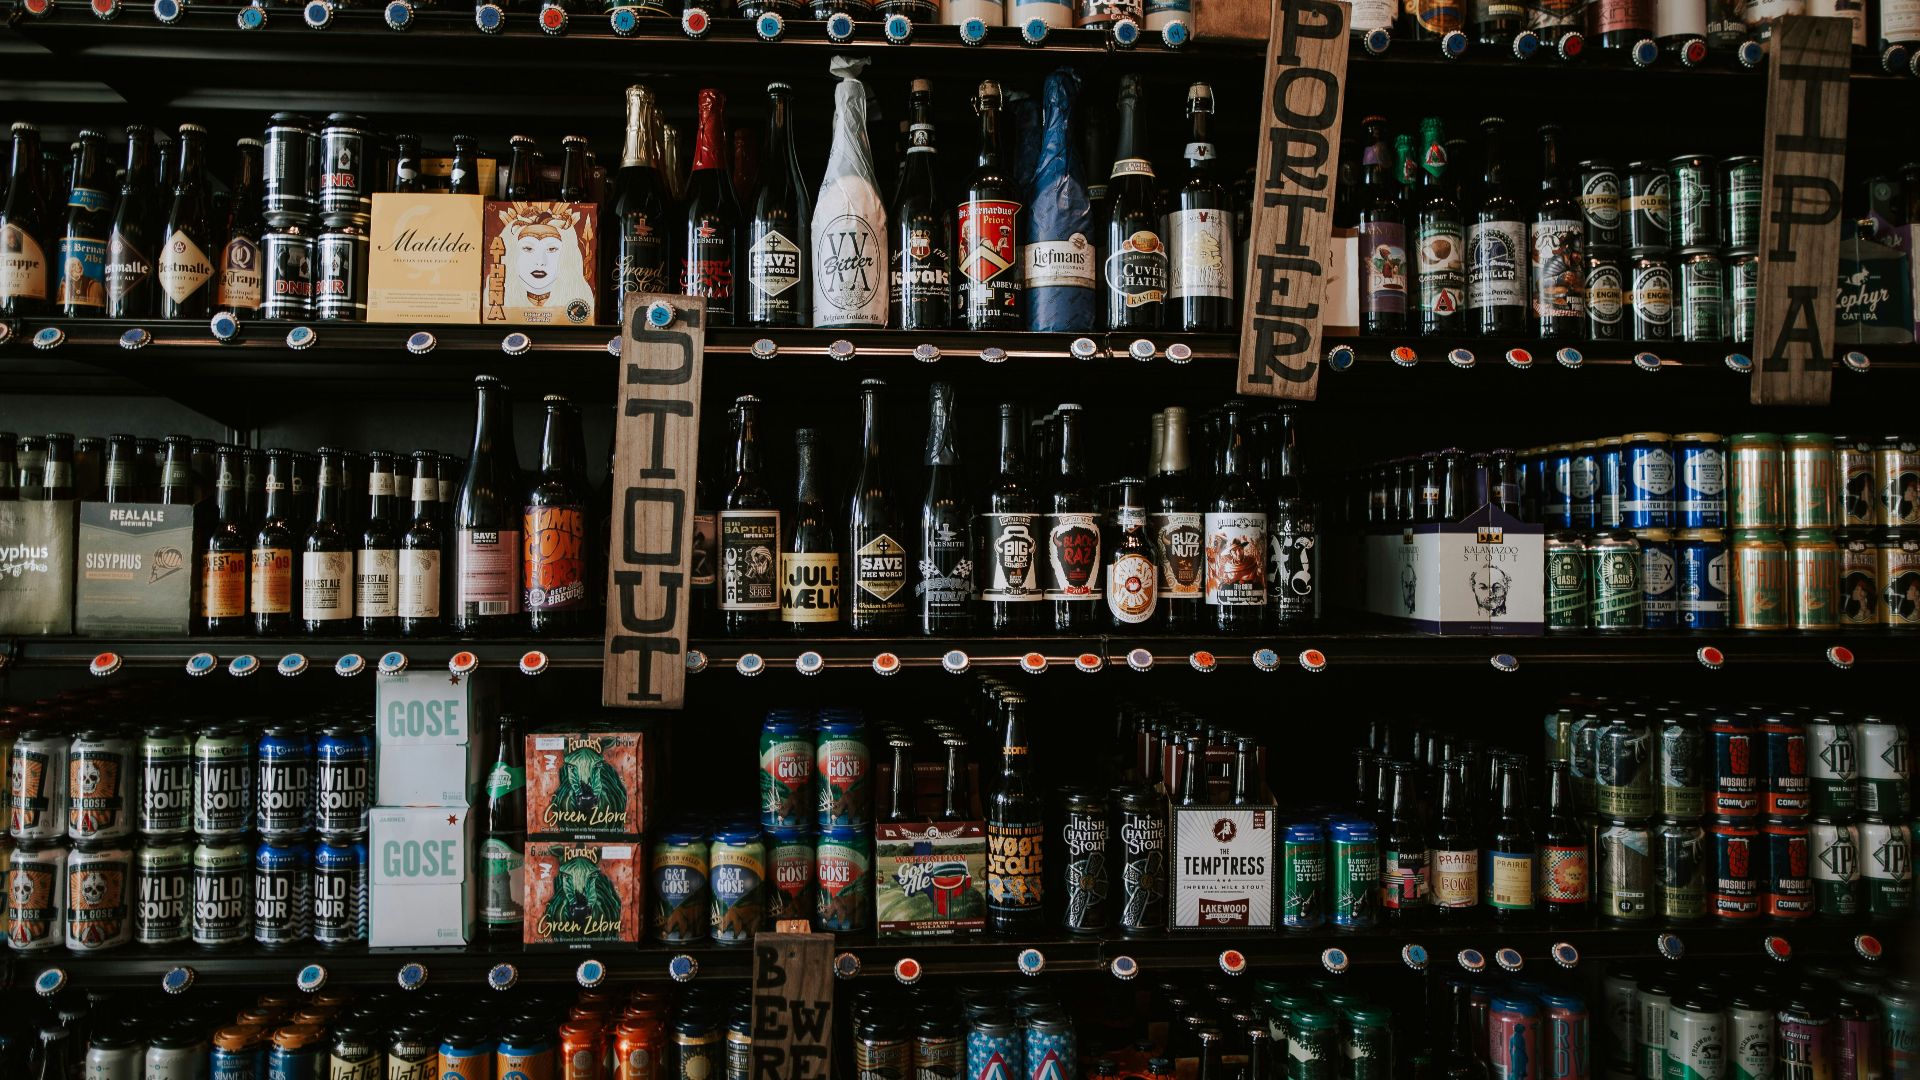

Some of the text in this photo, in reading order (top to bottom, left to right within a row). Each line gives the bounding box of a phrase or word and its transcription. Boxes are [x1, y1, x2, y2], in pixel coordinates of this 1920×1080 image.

[1248, 0, 1345, 385] PORTER
[1640, 198, 1655, 206] OLD
[983, 214, 1005, 225] Prior
[1762, 64, 1850, 373] IPA
[377, 228, 475, 253] Matilda
[1032, 246, 1086, 268] Liefmans
[823, 255, 874, 275] Bitter
[487, 236, 506, 320] ATHENA
[990, 281, 1012, 289] ABBEY
[1418, 273, 1447, 284] COCONUT
[275, 280, 312, 295] DNR
[1833, 280, 1890, 309] Zephyr
[846, 313, 869, 321] Golden
[870, 313, 879, 321] Ale
[1841, 312, 1878, 321] OAT IPA
[611, 306, 702, 701] STOUT
[109, 509, 165, 523] REAL ALE
[473, 532, 497, 540] SAVE
[724, 525, 775, 534] BAPTIST
[1062, 534, 1092, 548] BLACK
[1171, 532, 1200, 546] BUZZ
[1003, 540, 1029, 556] BIG
[1171, 544, 1200, 558] NUTZ
[1463, 545, 1519, 554] KALAMAZOO
[85, 552, 142, 570] SISYPHUS
[275, 556, 290, 569] 09
[1063, 546, 1092, 566] RAZ
[1463, 553, 1519, 562] STOUT
[230, 559, 244, 574] 08
[861, 557, 903, 571] SAVE
[329, 578, 341, 588] ALE
[378, 574, 389, 583] ALE
[788, 565, 839, 587] JULE
[1556, 575, 1577, 585] OASIS
[550, 587, 566, 596] DEEP
[781, 588, 839, 609] MÆLK
[387, 699, 460, 738] GOSE
[1828, 743, 1856, 773] IPA
[778, 761, 810, 779] GOSE
[827, 761, 860, 777] GOSE
[1719, 776, 1747, 788] MOSAIC
[1778, 776, 1804, 788] MOSAIC
[83, 798, 107, 808] GOSE
[144, 792, 191, 810] SOUR
[261, 791, 307, 810] SOUR
[320, 791, 365, 810] SOUR
[1717, 797, 1758, 809] COMMUNITY
[543, 802, 627, 827] Green Zebra
[382, 839, 457, 878] GOSE
[895, 854, 966, 863] WATERMELON
[987, 854, 1044, 875] STOUT
[1183, 856, 1266, 876] TEMPTRESS
[1438, 854, 1477, 866] PRAIRIE
[1496, 860, 1529, 869] PRAIRIE
[1830, 845, 1858, 875] IPA
[1882, 843, 1911, 874] IPA
[664, 868, 687, 881] G&T
[719, 867, 742, 881] G&T
[776, 865, 809, 883] GOSE
[819, 865, 850, 882] GOSE
[897, 861, 933, 885] Gose
[661, 880, 690, 895] GOSE
[716, 880, 745, 894] GOSE
[902, 875, 931, 897] Ale
[1718, 878, 1746, 890] MOSAIC
[1779, 878, 1805, 889] MOSAIC
[139, 900, 184, 919] SOUR
[196, 900, 242, 919] SOUR
[1200, 904, 1248, 914] LAKEWOOD
[1716, 899, 1758, 911] COMMUNITY
[89, 908, 113, 919] GOSE
[537, 913, 622, 938] Green Zebra
[755, 946, 786, 989] B
